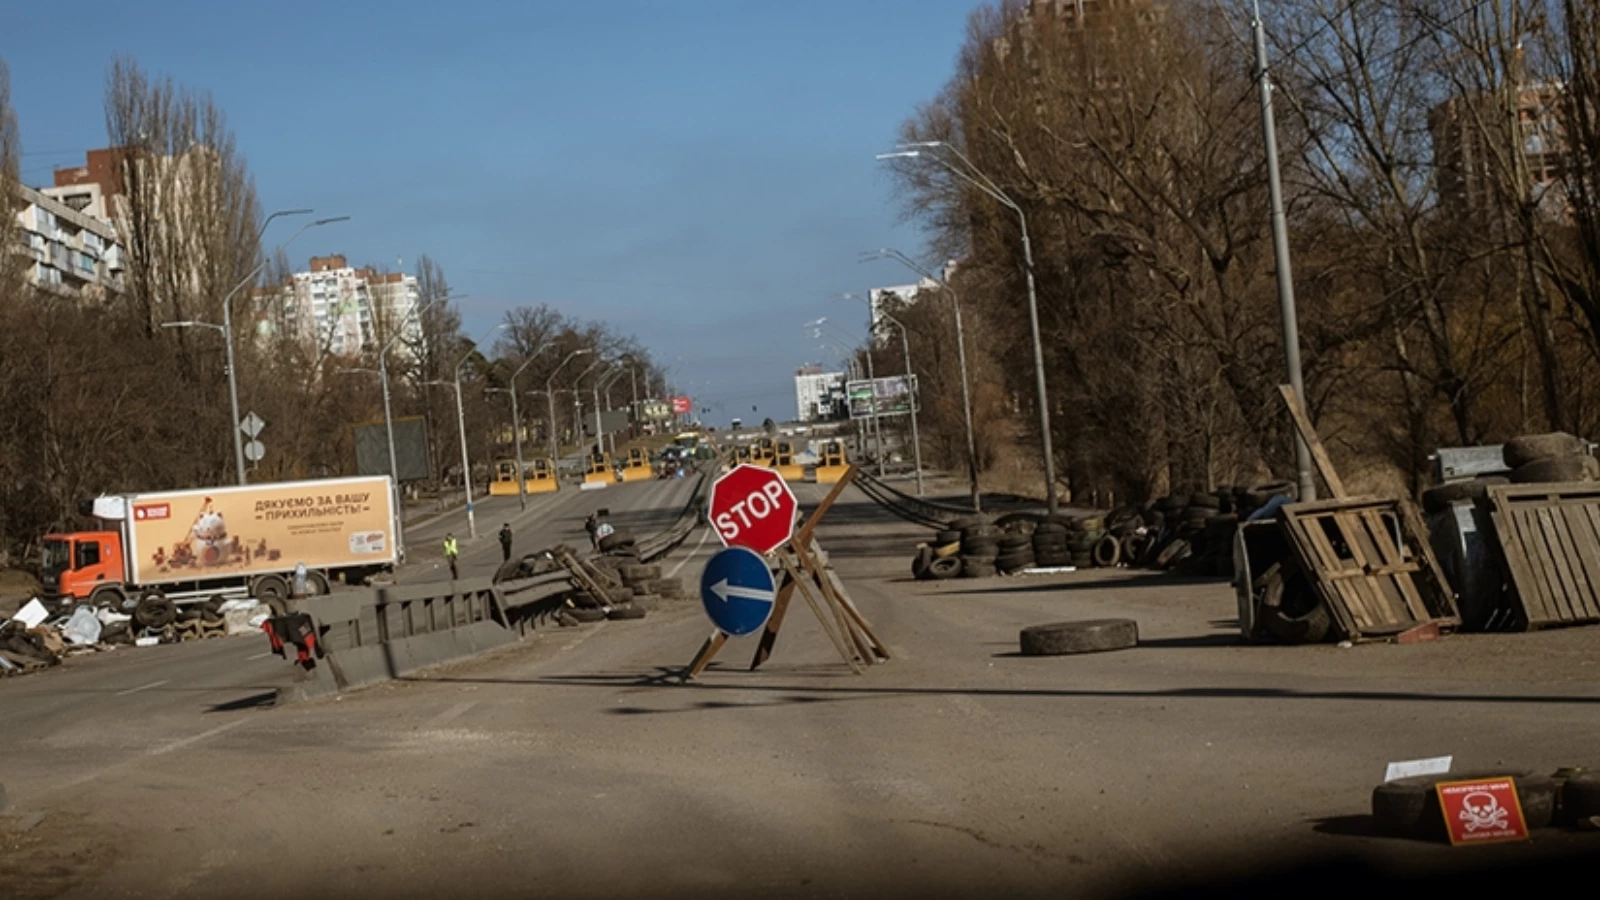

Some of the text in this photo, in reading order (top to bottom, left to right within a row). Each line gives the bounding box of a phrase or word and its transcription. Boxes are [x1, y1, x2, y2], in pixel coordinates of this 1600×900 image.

[254, 492, 371, 513] ДЯКУЄМО ЗА ВАШУ
[716, 480, 784, 540] STOP
